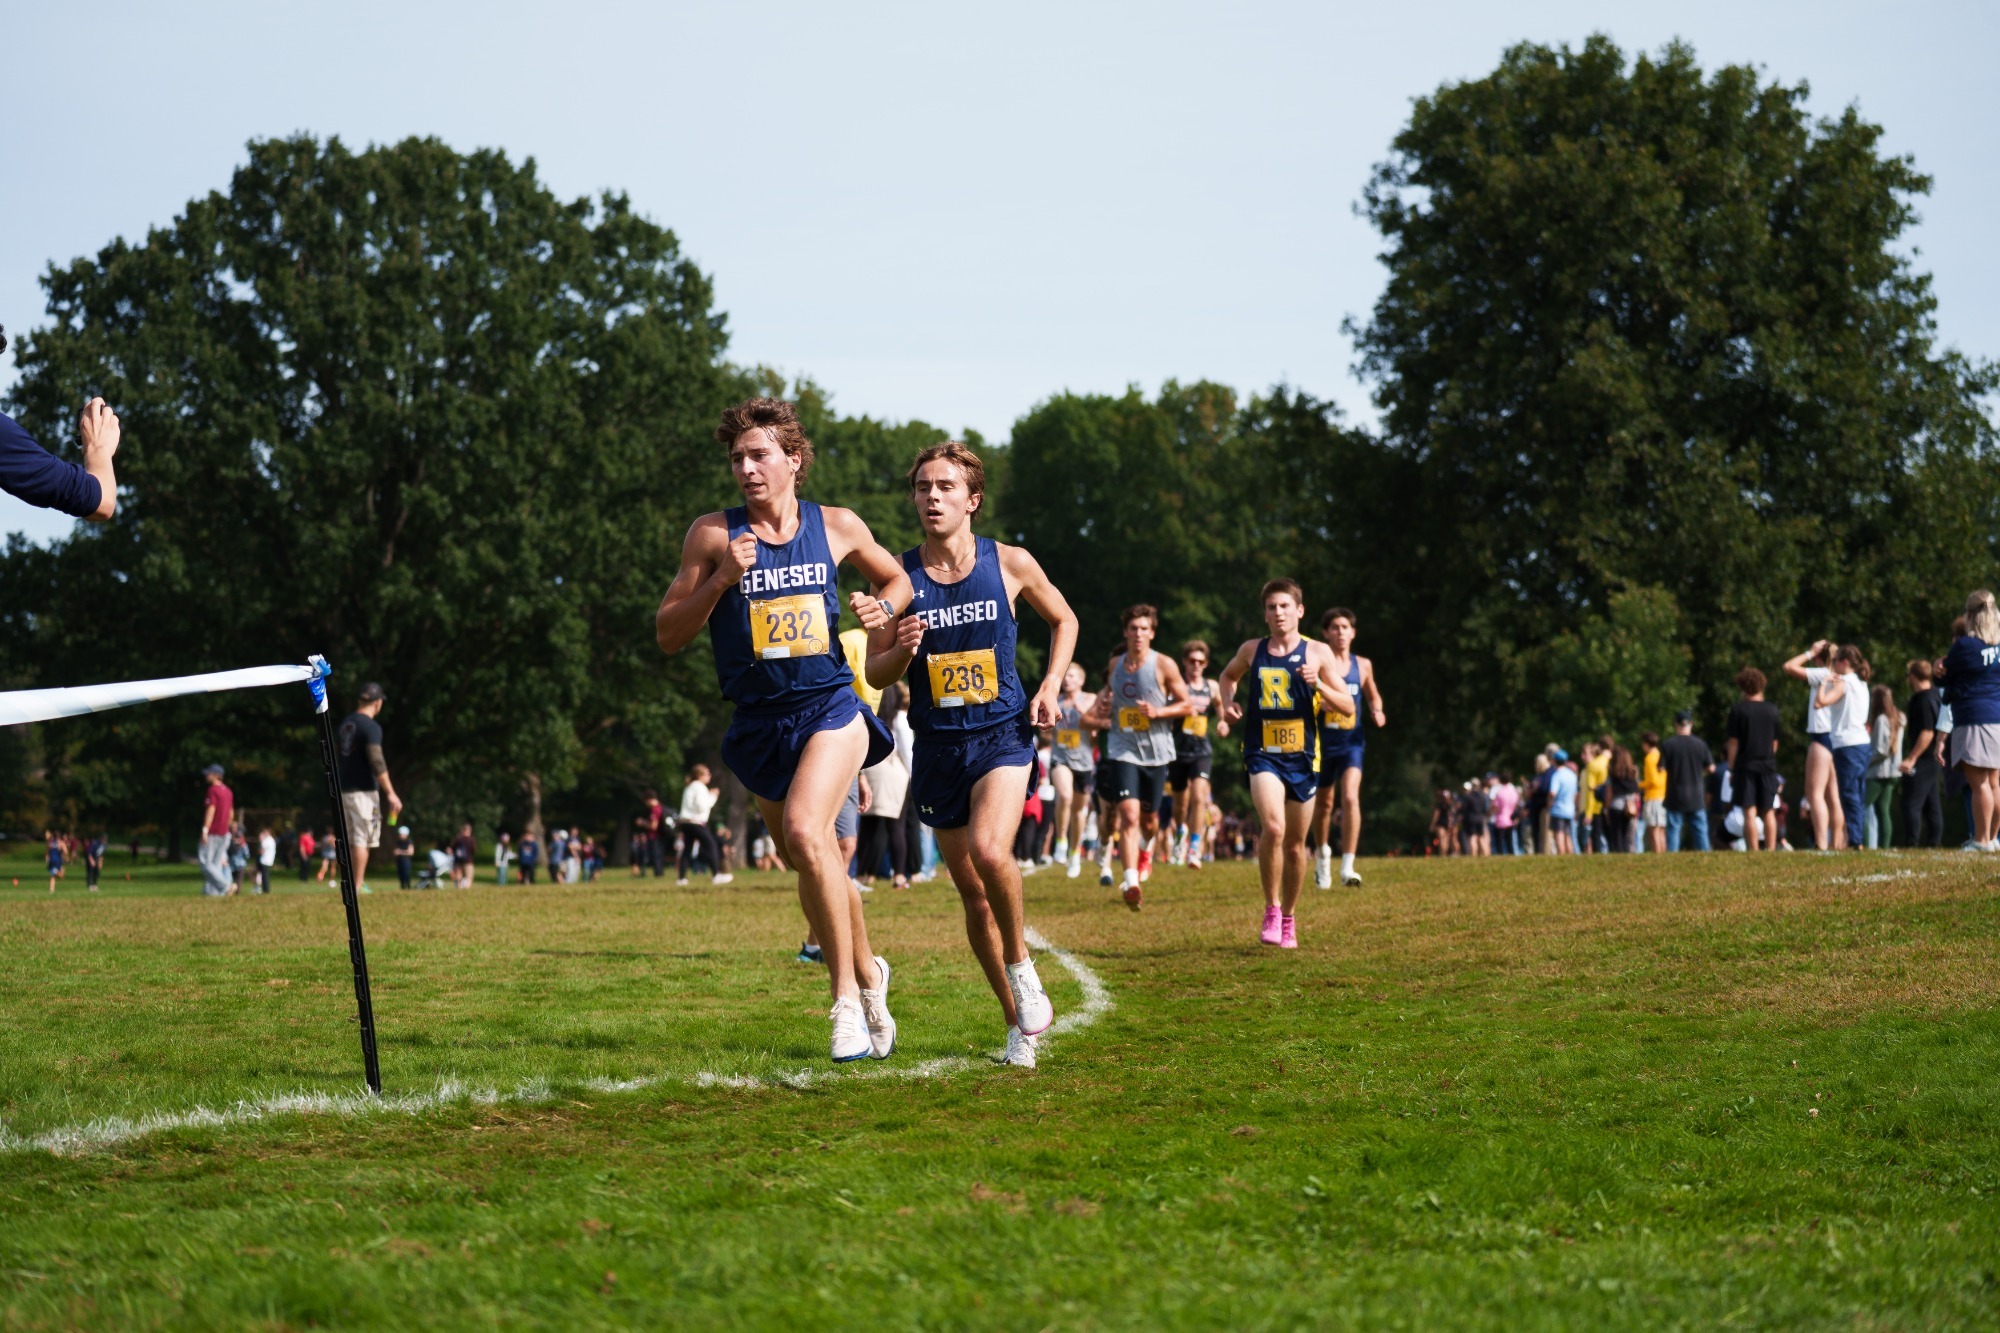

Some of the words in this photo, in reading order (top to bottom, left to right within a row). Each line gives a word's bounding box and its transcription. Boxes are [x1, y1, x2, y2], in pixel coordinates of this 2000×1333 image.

[741, 563, 827, 593] GENESEO
[766, 610, 814, 643] 232
[942, 664, 985, 693] 236
[1122, 681, 1137, 699] C
[1258, 667, 1294, 710] R
[1127, 713, 1140, 726] 66
[1272, 728, 1296, 744] 185
